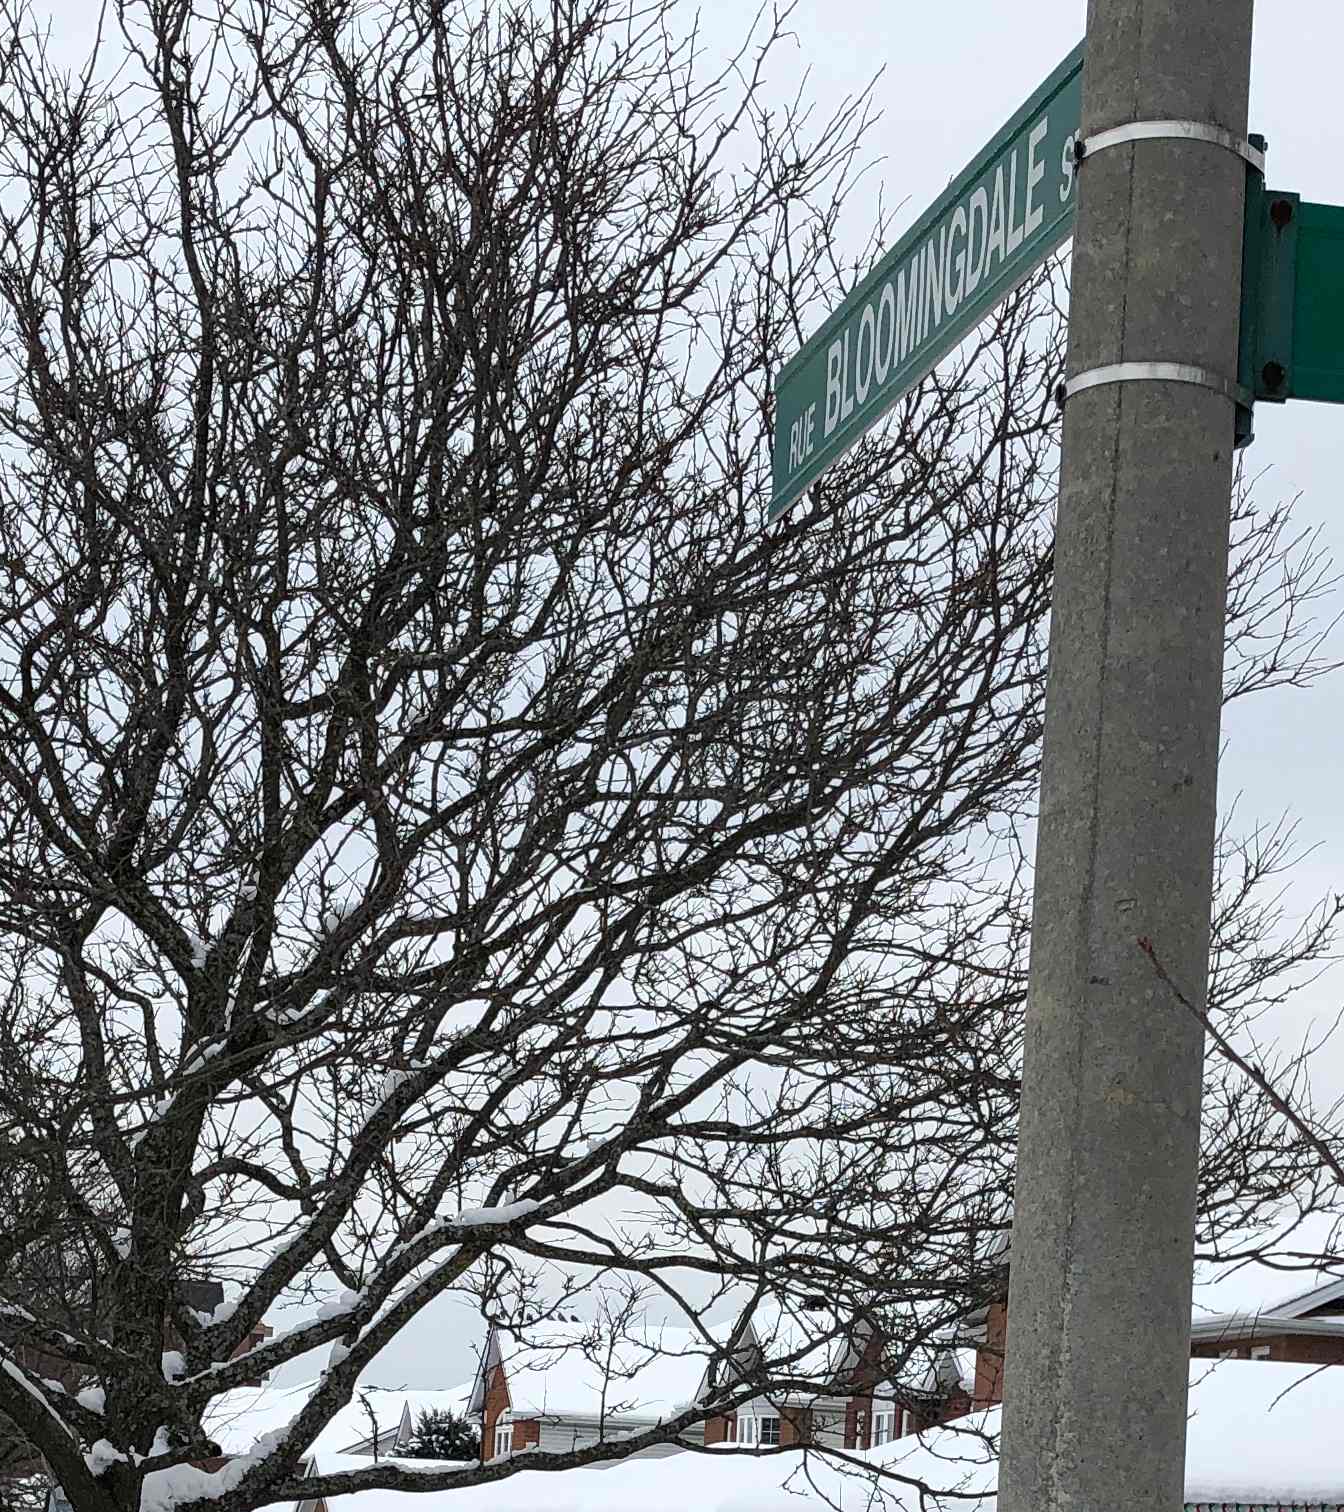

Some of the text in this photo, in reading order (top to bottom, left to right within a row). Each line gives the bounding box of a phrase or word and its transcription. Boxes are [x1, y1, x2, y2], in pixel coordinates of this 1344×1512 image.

[789, 117, 1081, 469] RUE BLOOMINGDALE S
